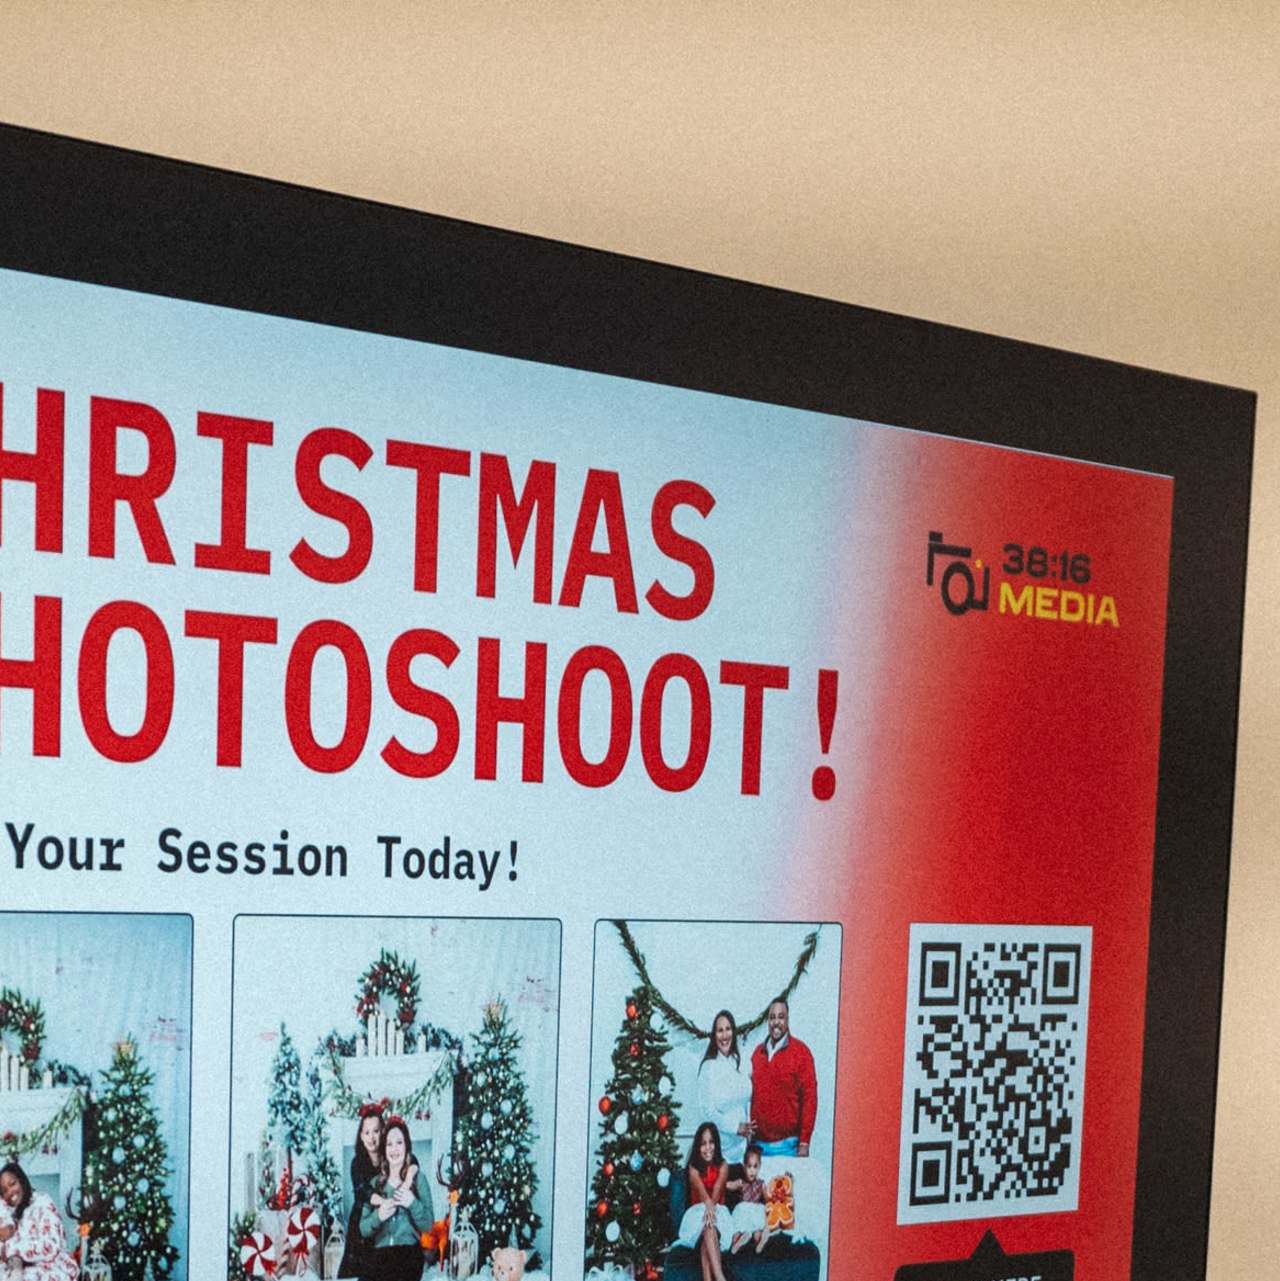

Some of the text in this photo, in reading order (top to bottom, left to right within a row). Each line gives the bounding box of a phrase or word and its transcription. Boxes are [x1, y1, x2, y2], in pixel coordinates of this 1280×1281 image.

[1001, 542, 1092, 585] 38:16
[998, 581, 1120, 627] MEDIA
[4, 821, 125, 872] Your
[156, 826, 348, 878] Session
[375, 834, 519, 892] Today!
